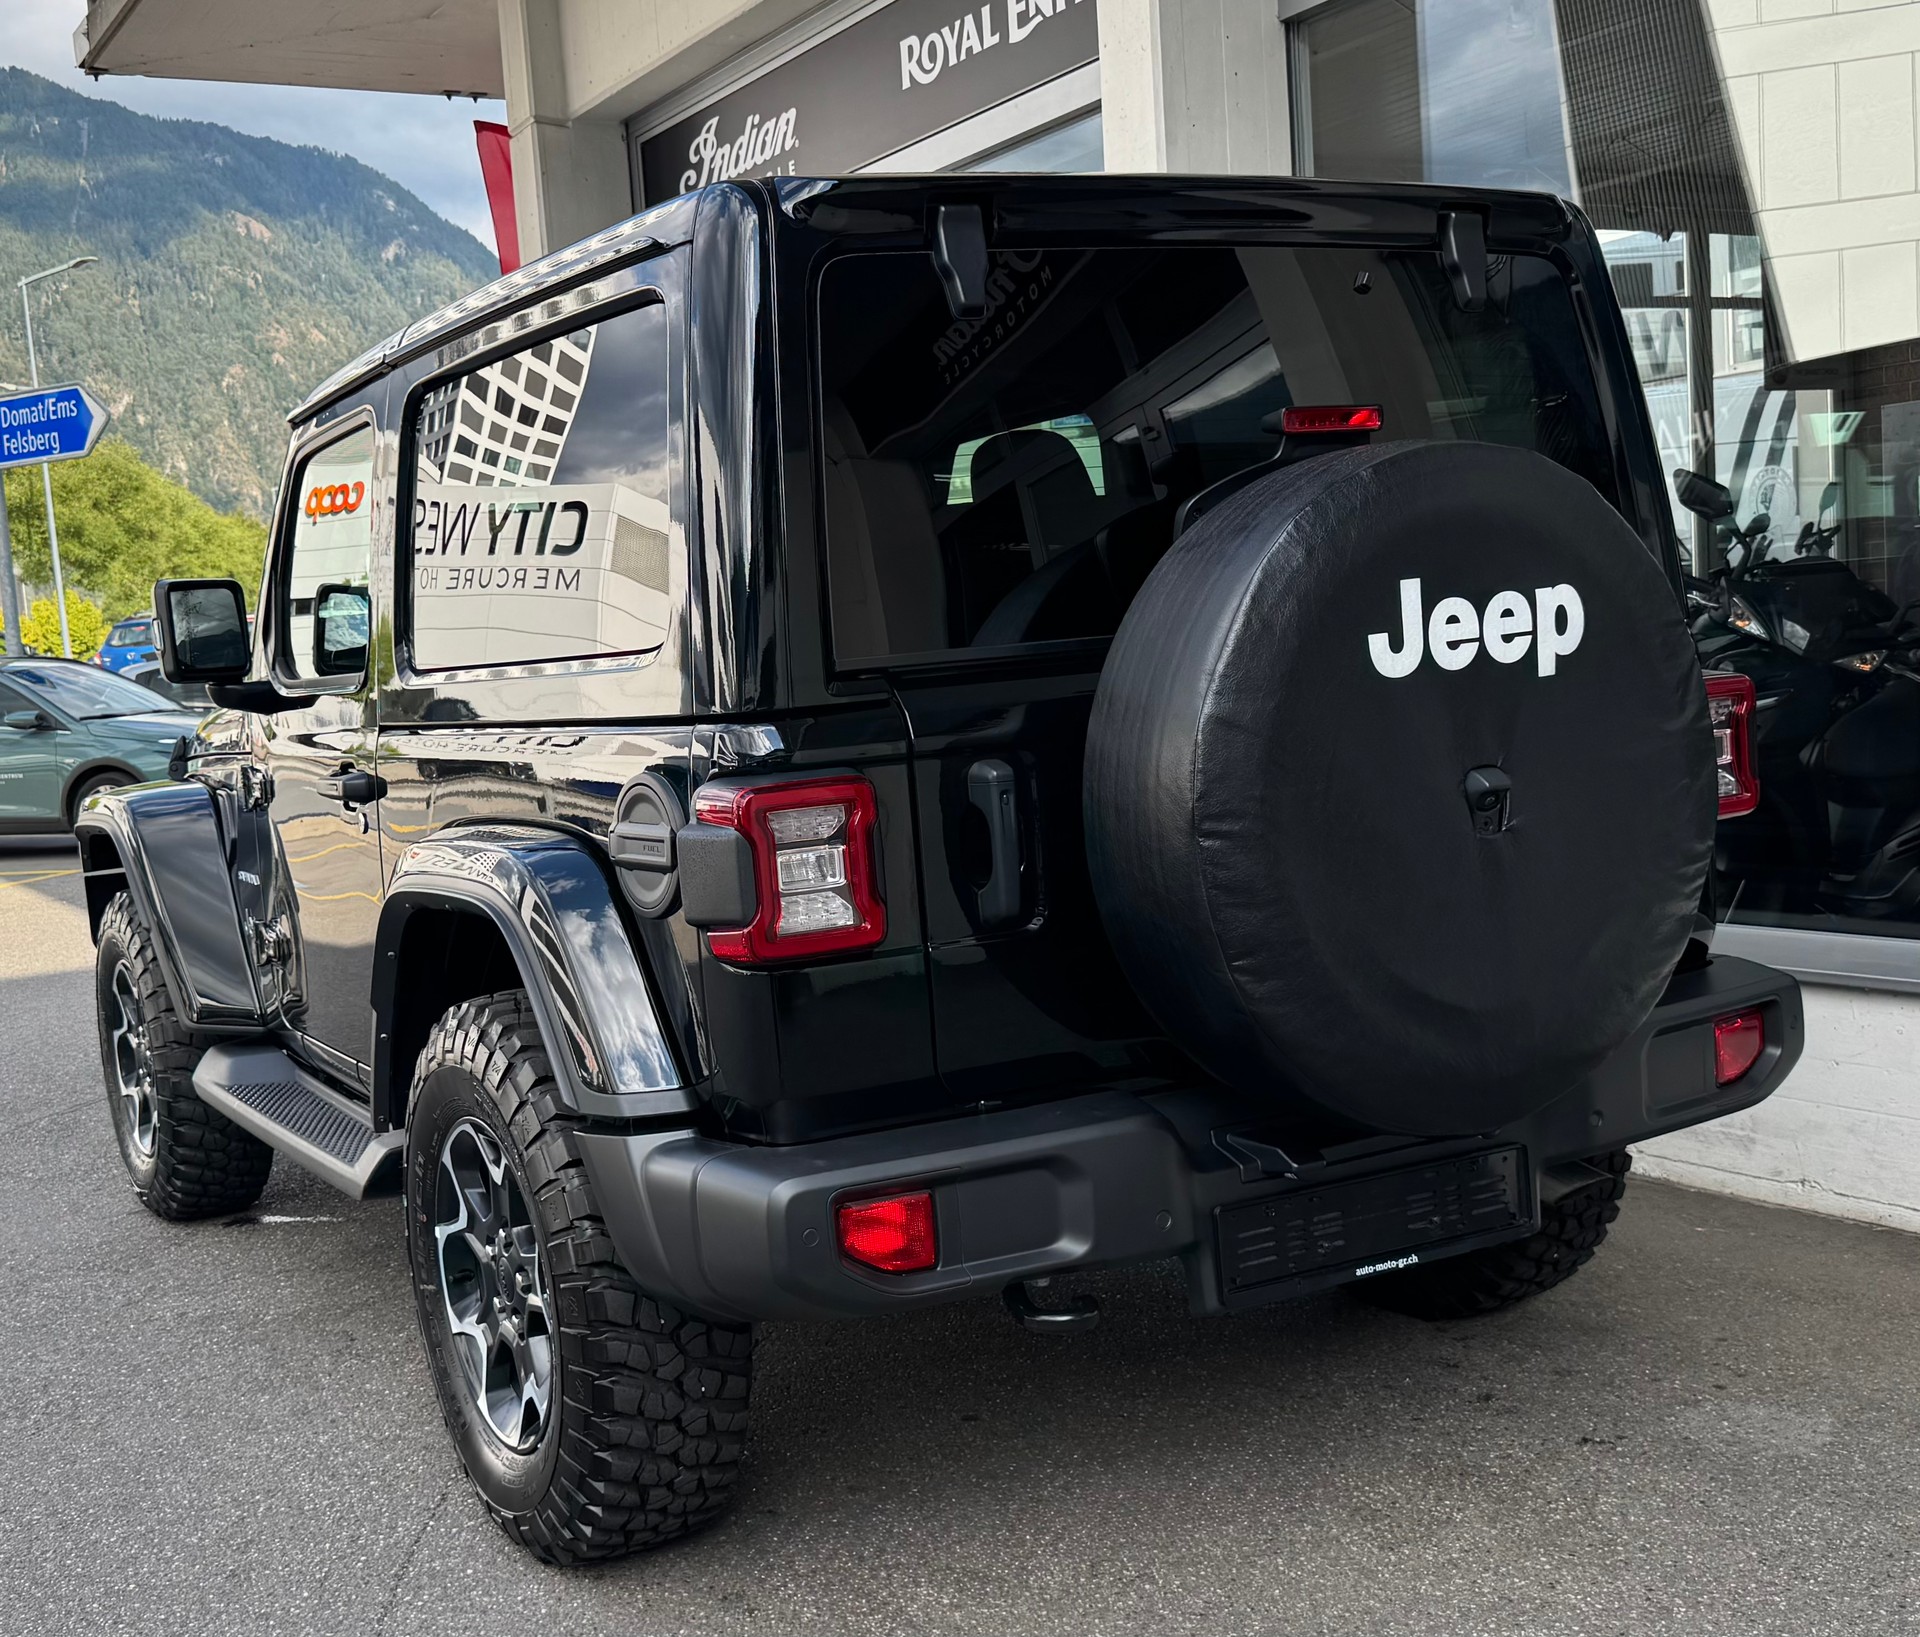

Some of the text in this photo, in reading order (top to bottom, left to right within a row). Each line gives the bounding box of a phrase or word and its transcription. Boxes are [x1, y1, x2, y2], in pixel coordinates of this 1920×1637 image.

[899, 4, 1000, 90] ROYAL
[0, 398, 78, 428] Domat/Ems
[3, 429, 60, 455] Felsberg
[1368, 577, 1585, 678] Jeep
[642, 844, 662, 853] FUEL
[1355, 1253, 1419, 1277] auto-moto-gr.ch
